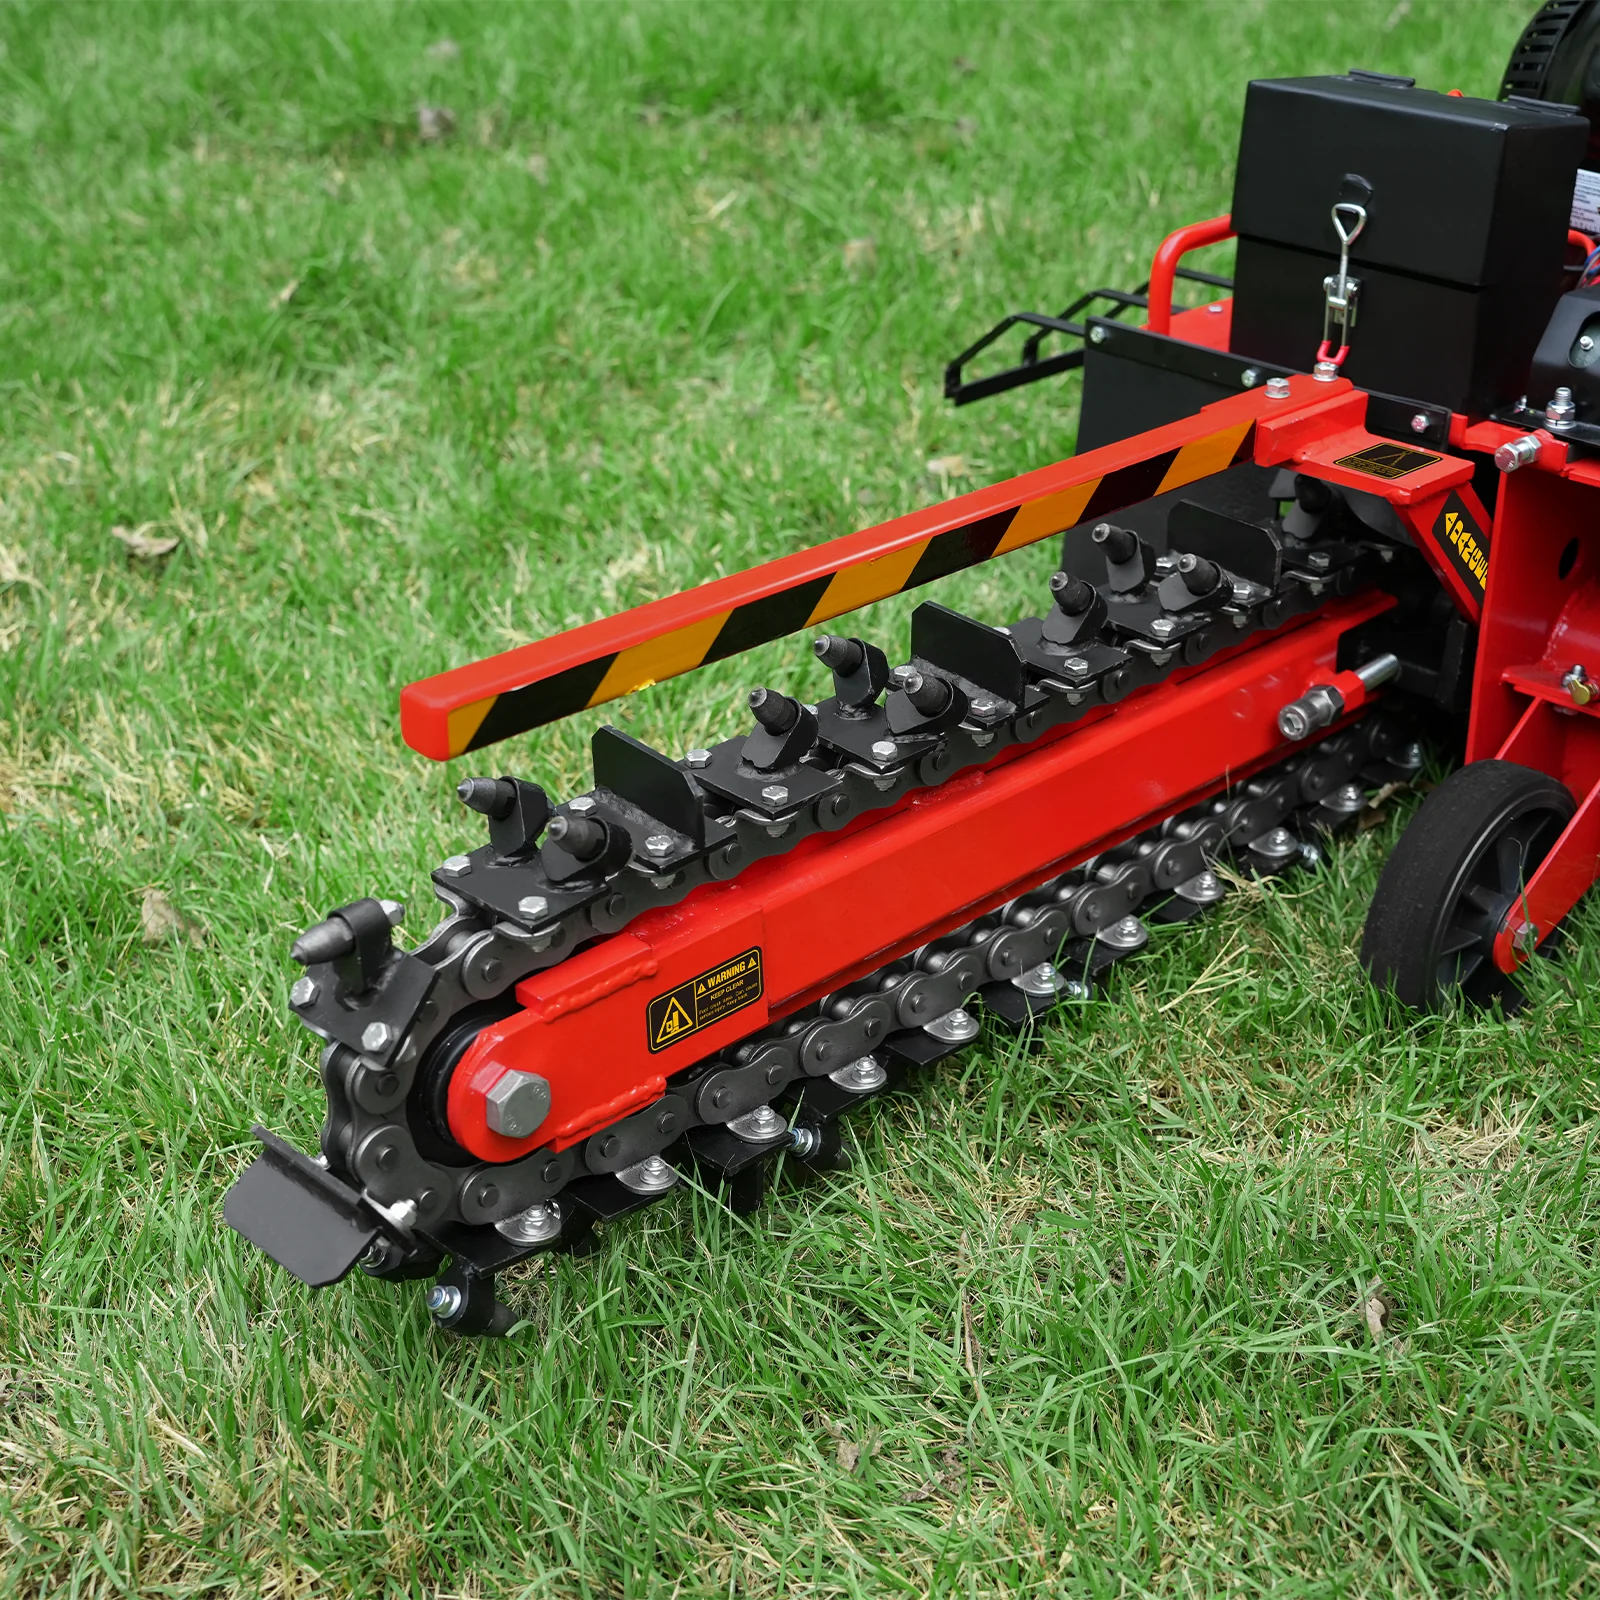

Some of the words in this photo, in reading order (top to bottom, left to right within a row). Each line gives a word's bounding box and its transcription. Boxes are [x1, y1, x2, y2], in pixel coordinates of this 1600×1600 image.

[707, 961, 746, 989] WARNING
[710, 989, 725, 1001] KEEP
[725, 979, 744, 993] CLEAR
